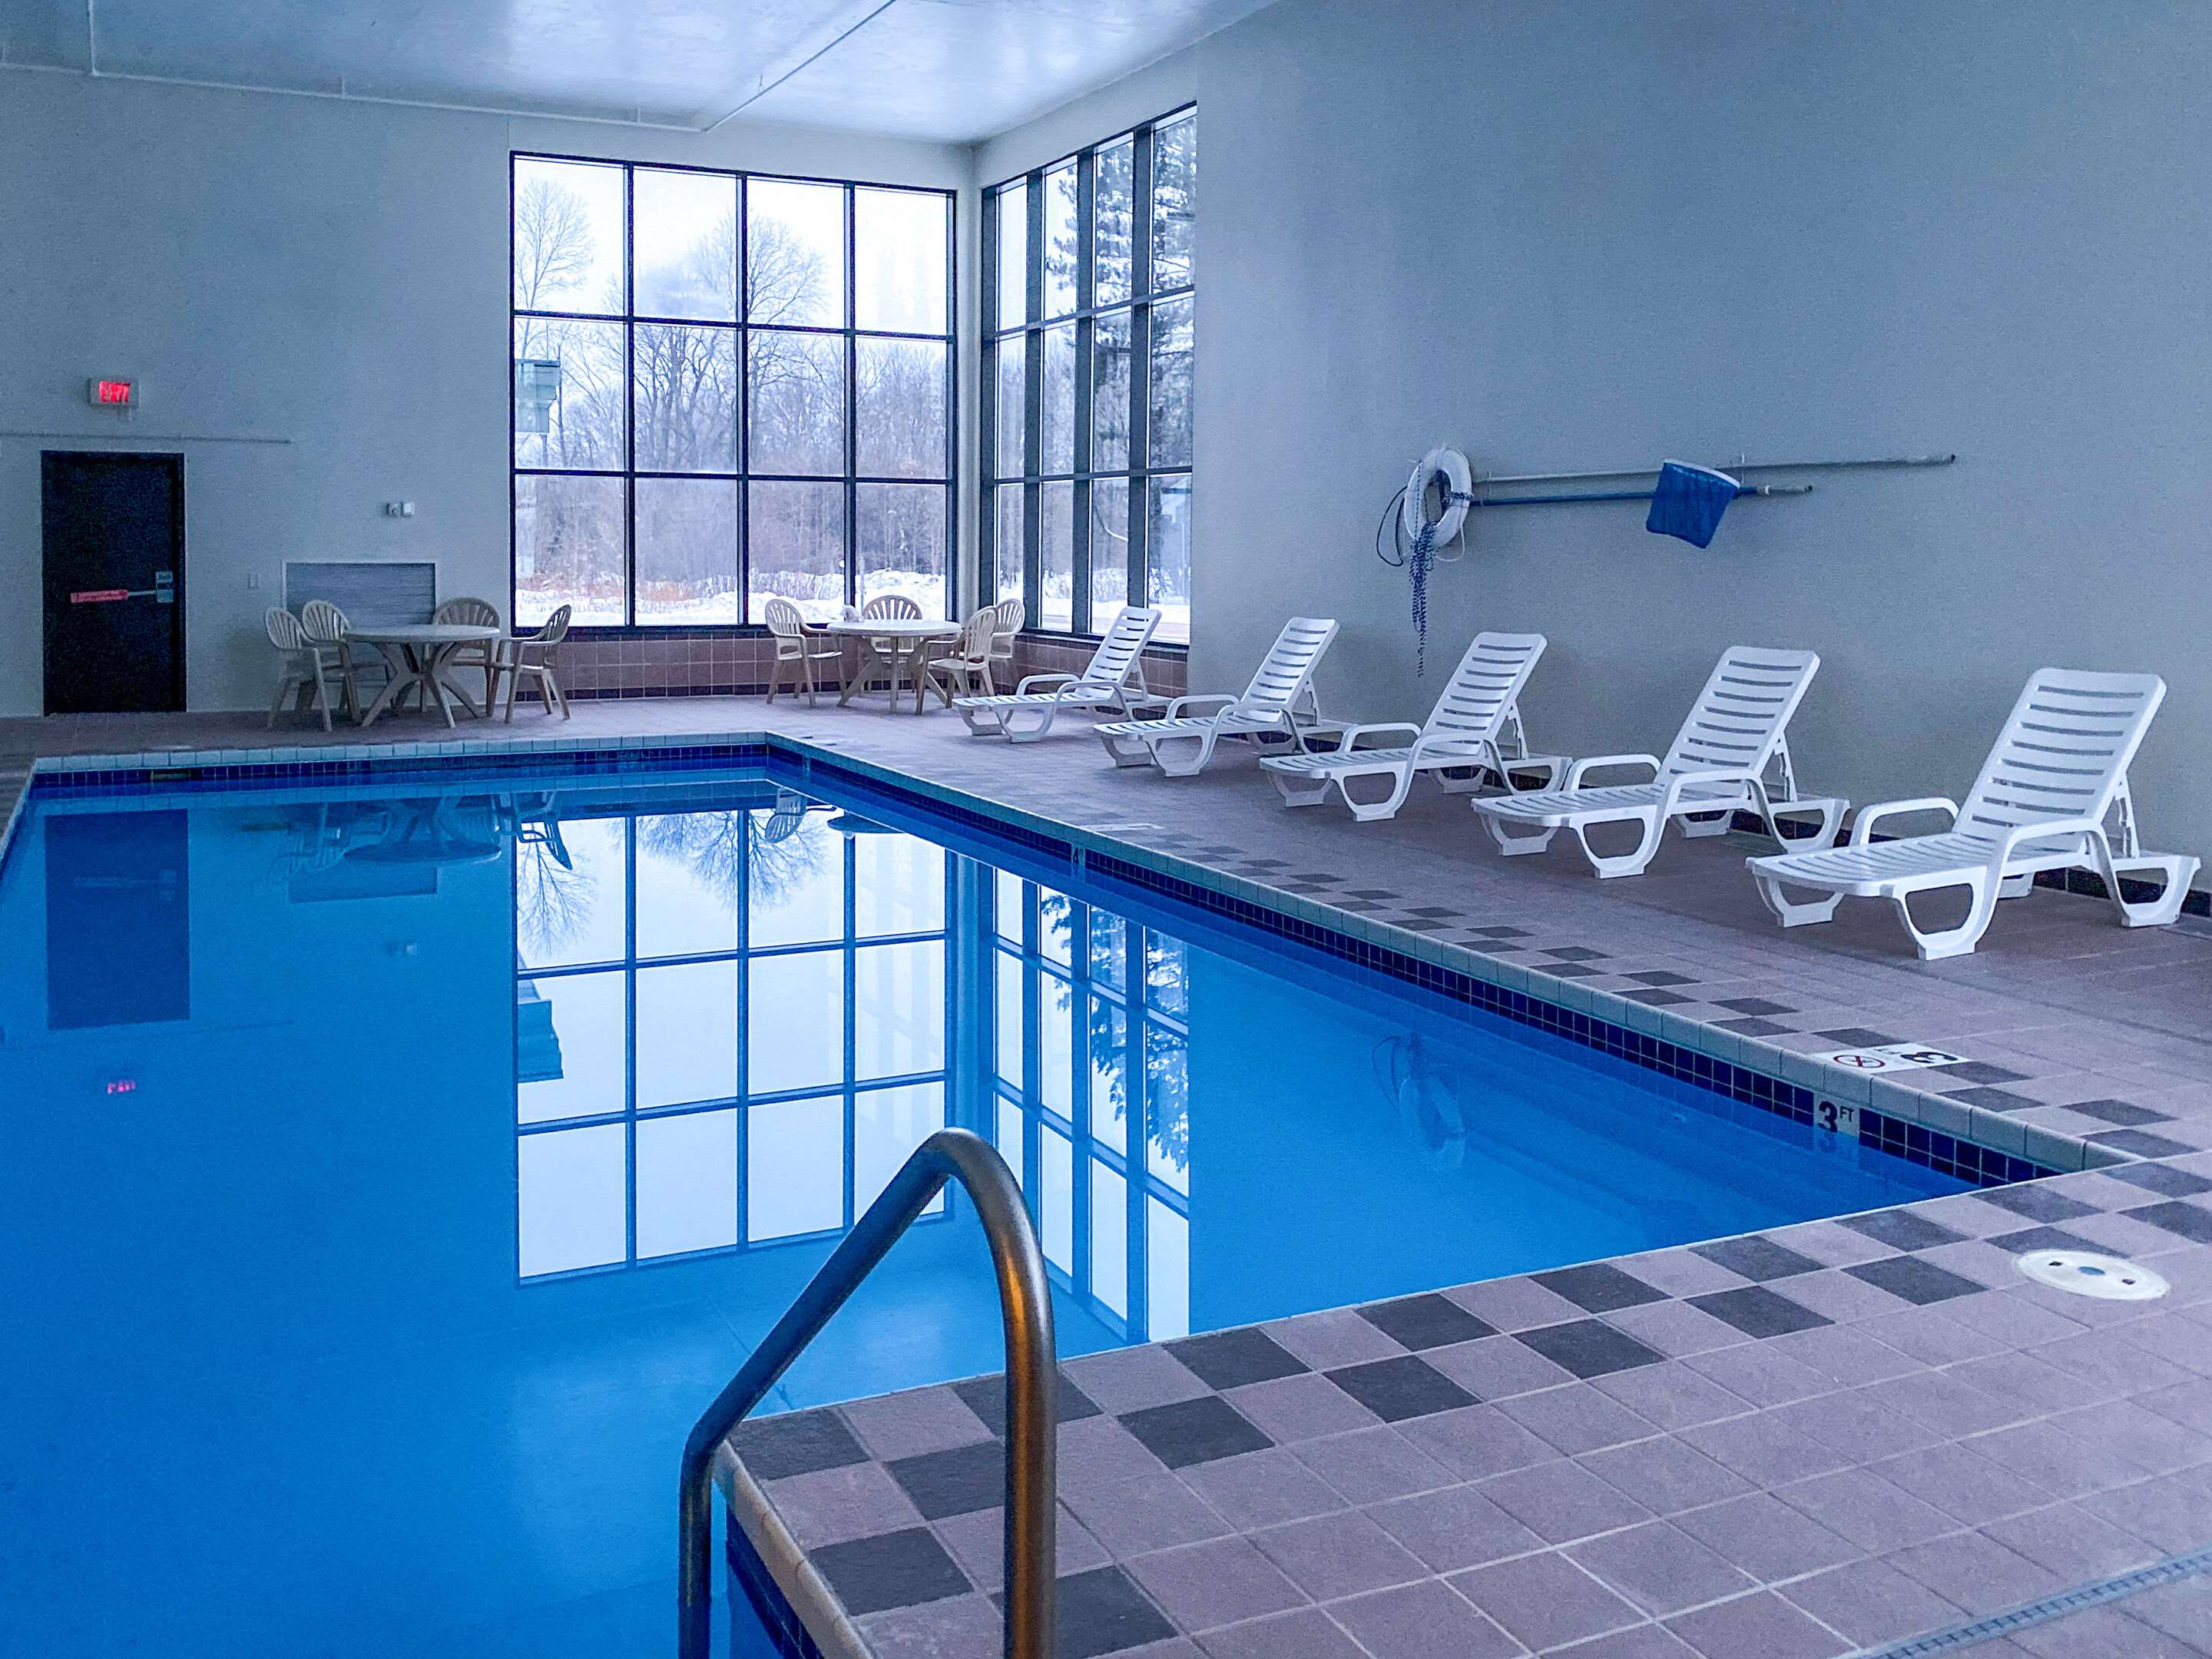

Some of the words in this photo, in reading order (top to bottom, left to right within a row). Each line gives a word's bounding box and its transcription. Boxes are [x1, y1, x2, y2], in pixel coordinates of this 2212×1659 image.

[98, 381, 131, 404] EXIT
[1818, 1101, 1838, 1133] 3
[1839, 1106, 1855, 1122] FT
